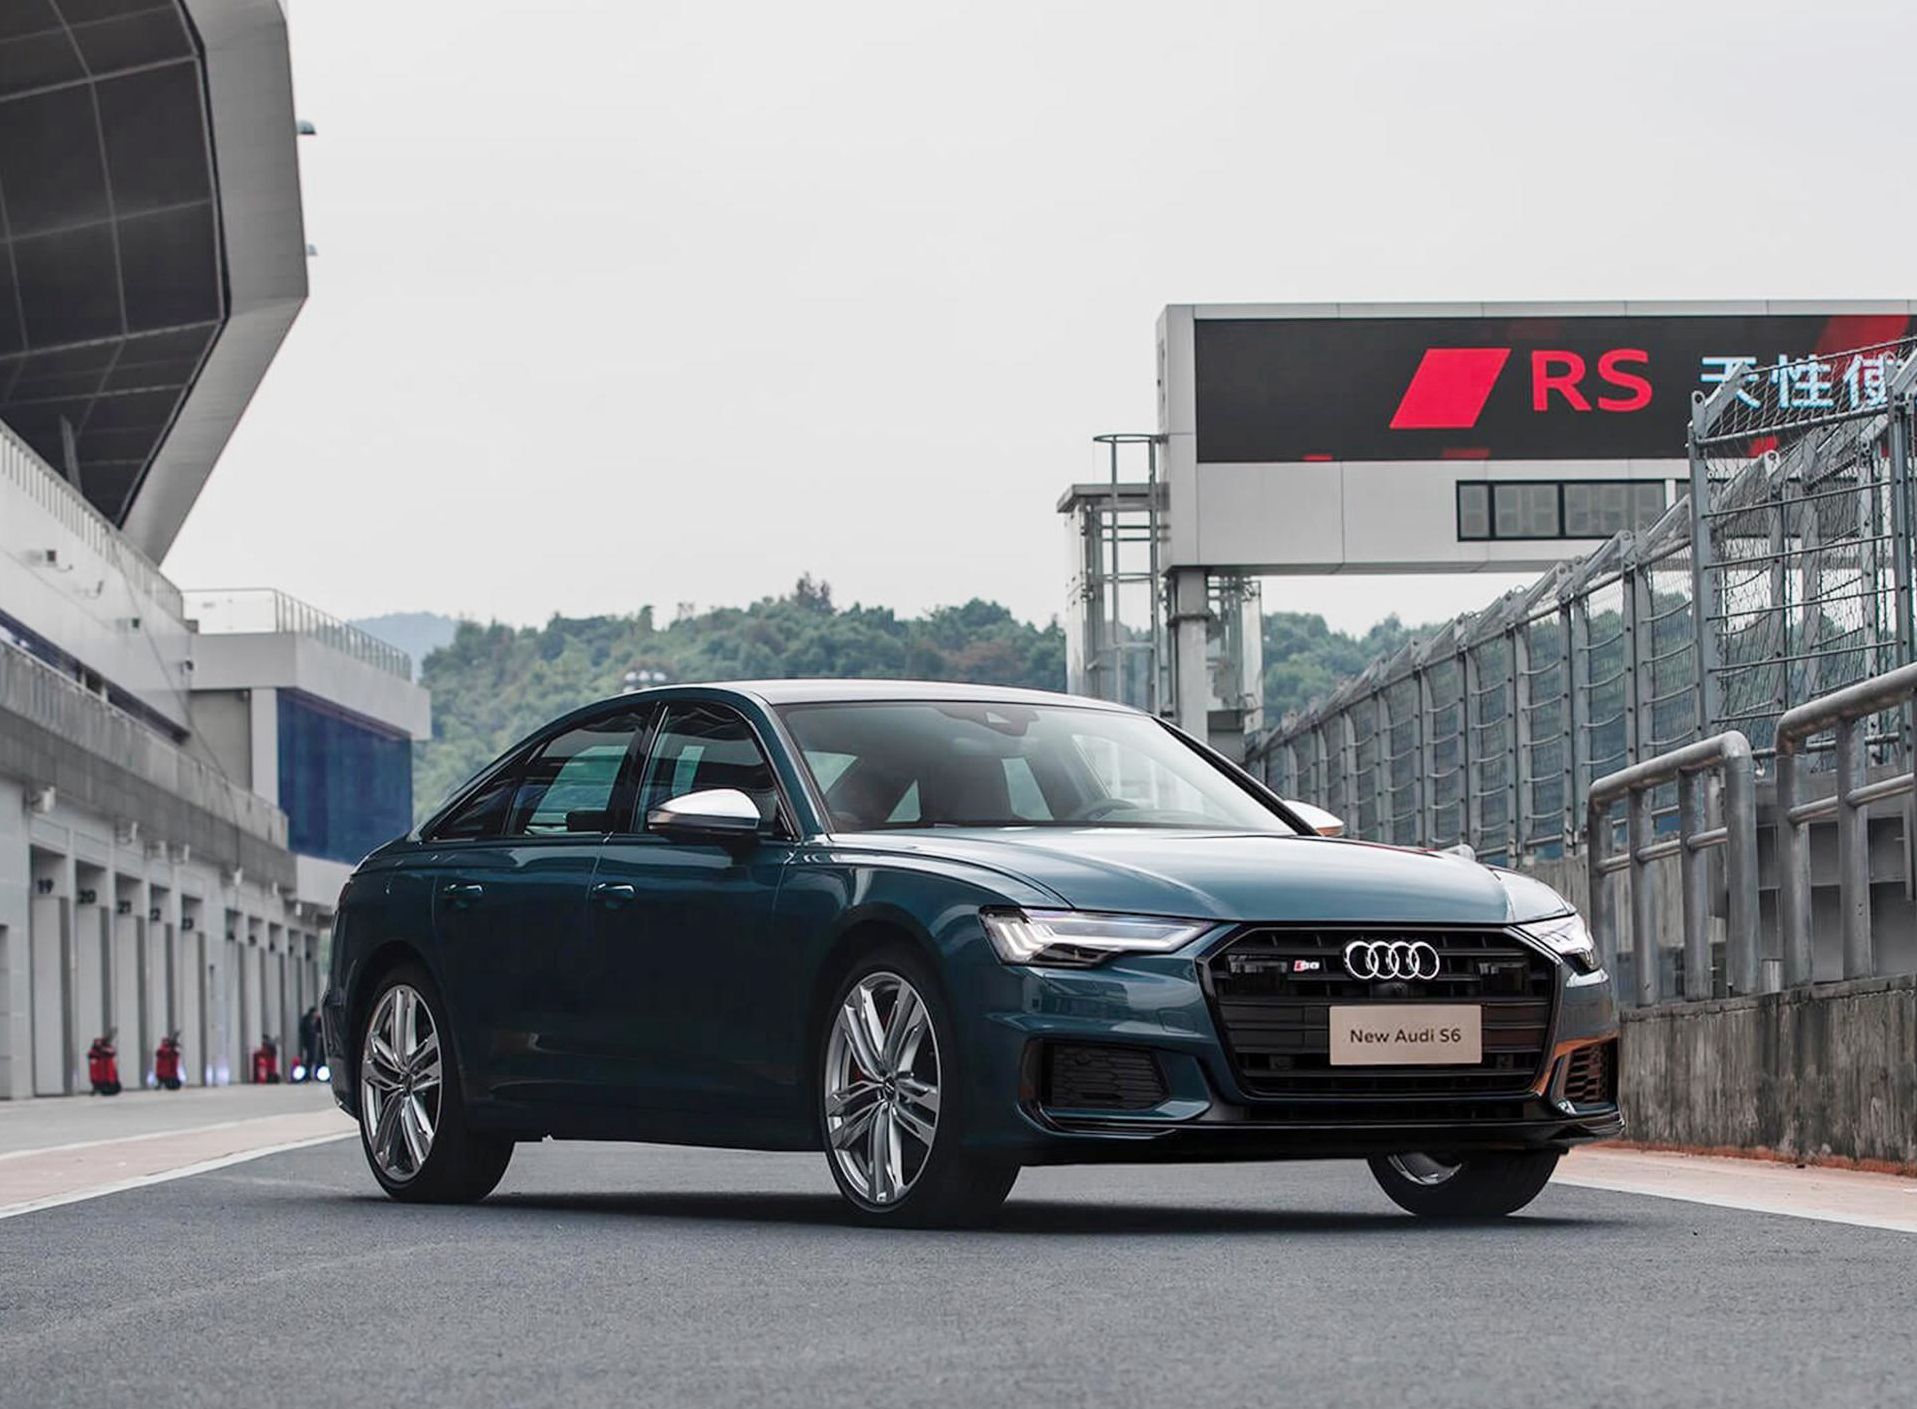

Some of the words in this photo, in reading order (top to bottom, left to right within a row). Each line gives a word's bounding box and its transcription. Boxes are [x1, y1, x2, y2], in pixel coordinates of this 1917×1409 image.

[1531, 348, 1653, 412] RS
[1350, 1029, 1390, 1043] New
[1394, 1029, 1434, 1043] Audi
[1440, 1028, 1462, 1043] S6
